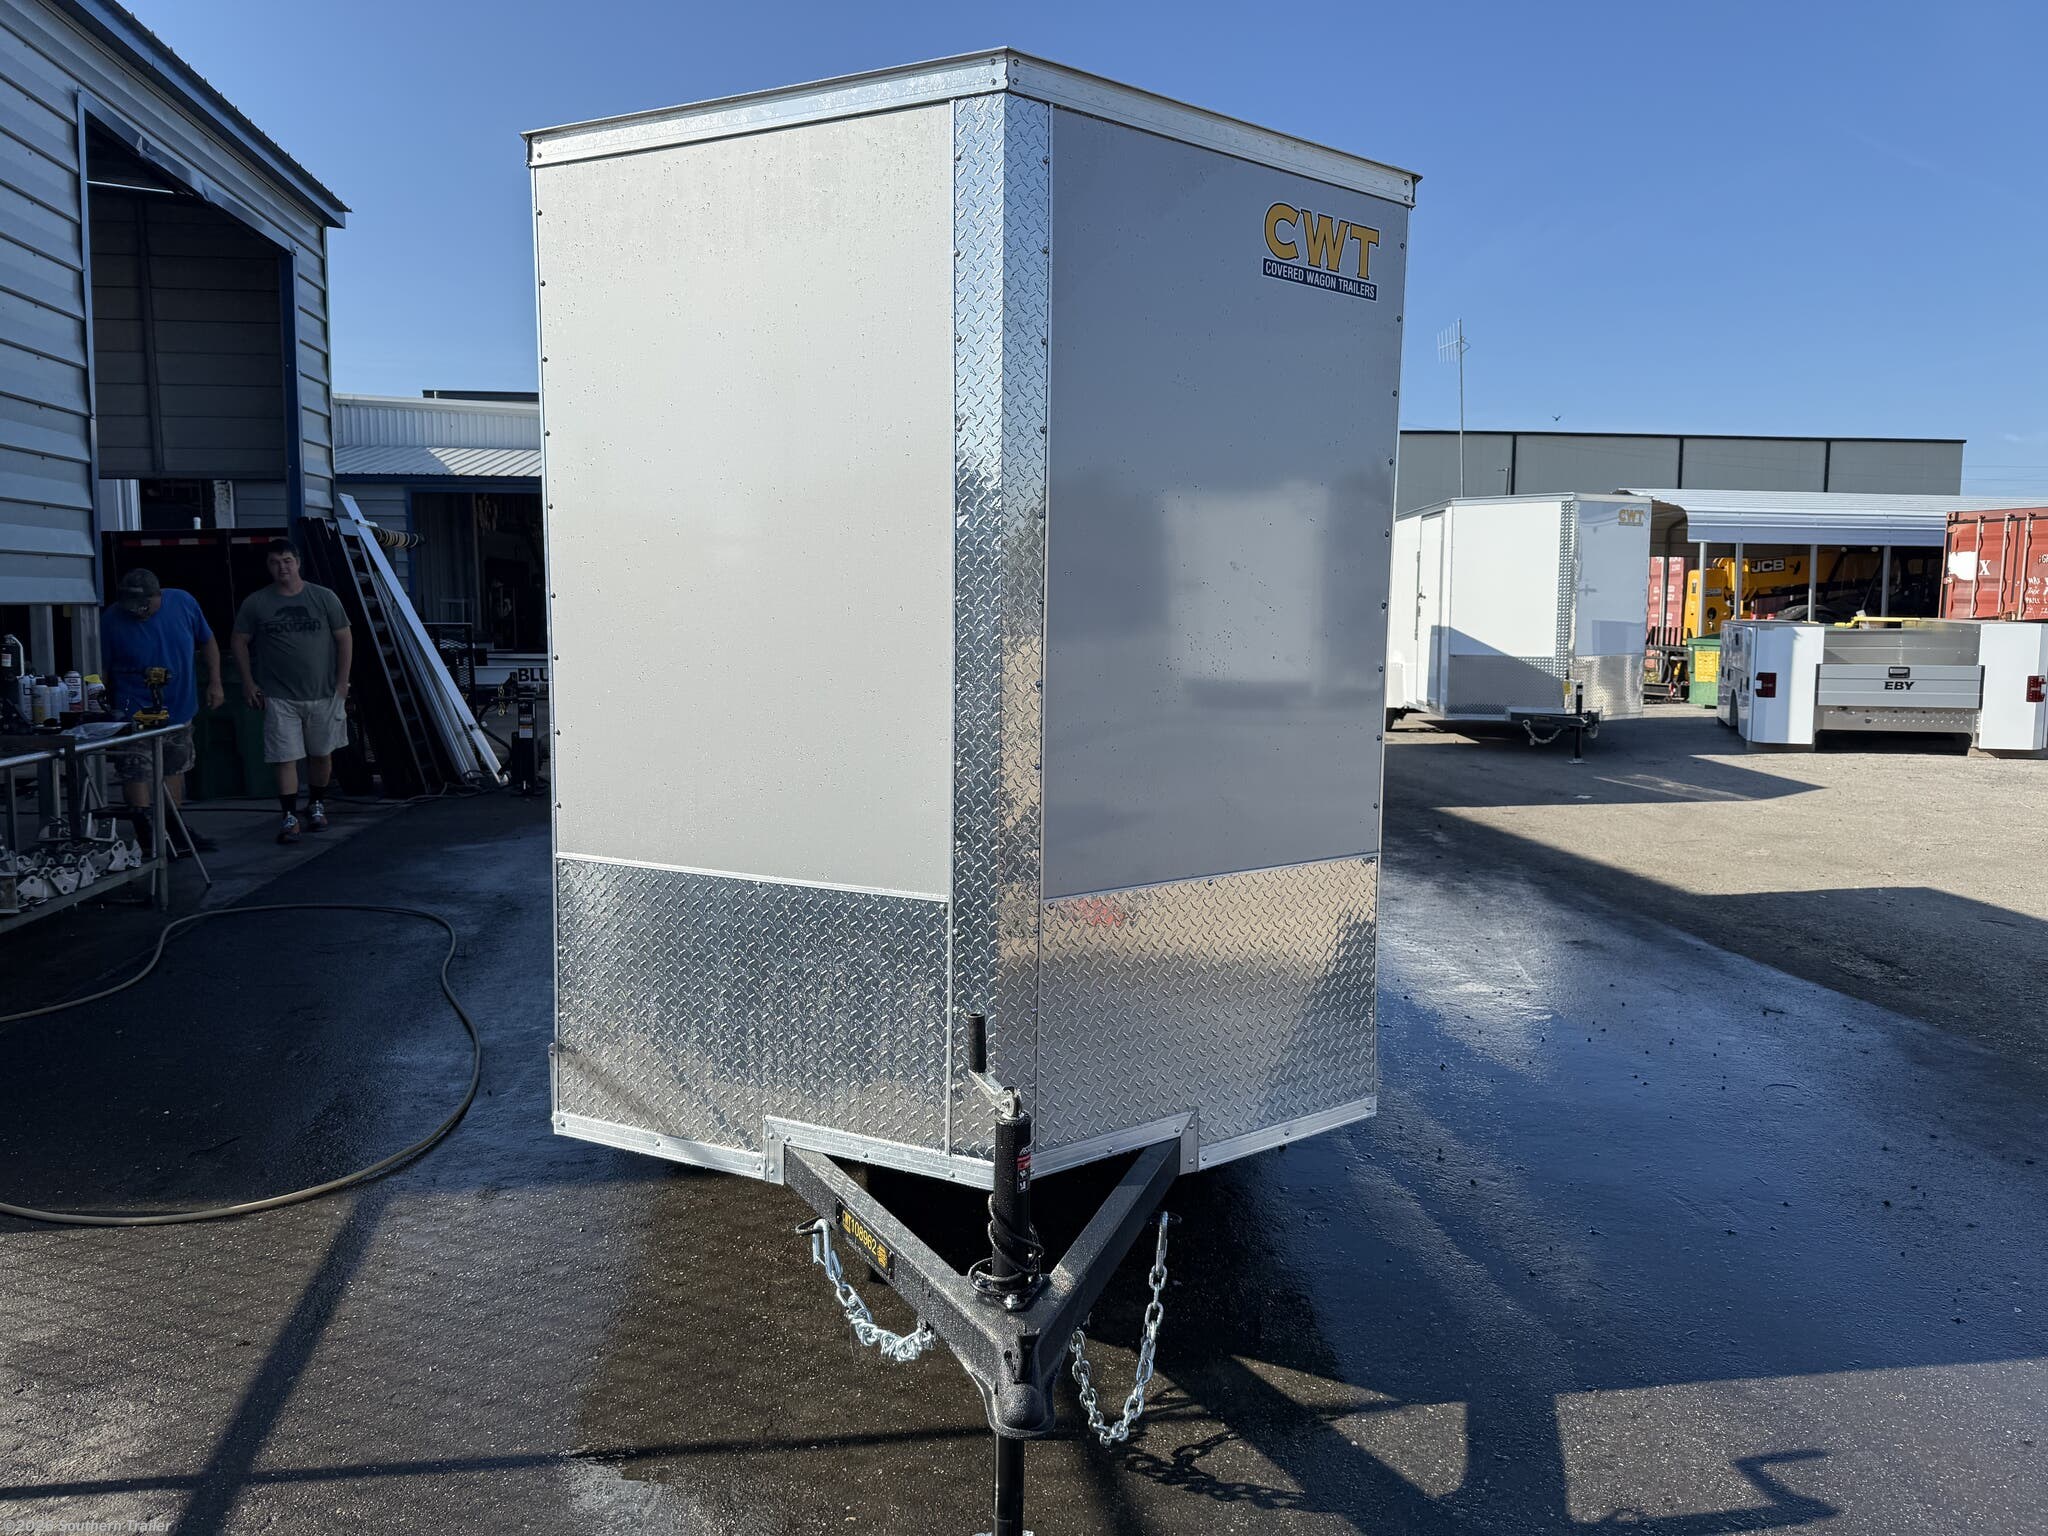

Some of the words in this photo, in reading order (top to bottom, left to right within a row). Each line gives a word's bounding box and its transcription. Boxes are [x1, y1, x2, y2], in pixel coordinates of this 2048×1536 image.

[1265, 202, 1380, 280] CWT
[1265, 261, 1304, 281] COVERED
[1306, 270, 1337, 289] WAGON
[1338, 278, 1375, 298] TRAILERS
[1751, 560, 1785, 572] JCB
[1884, 681, 1915, 690] EBY
